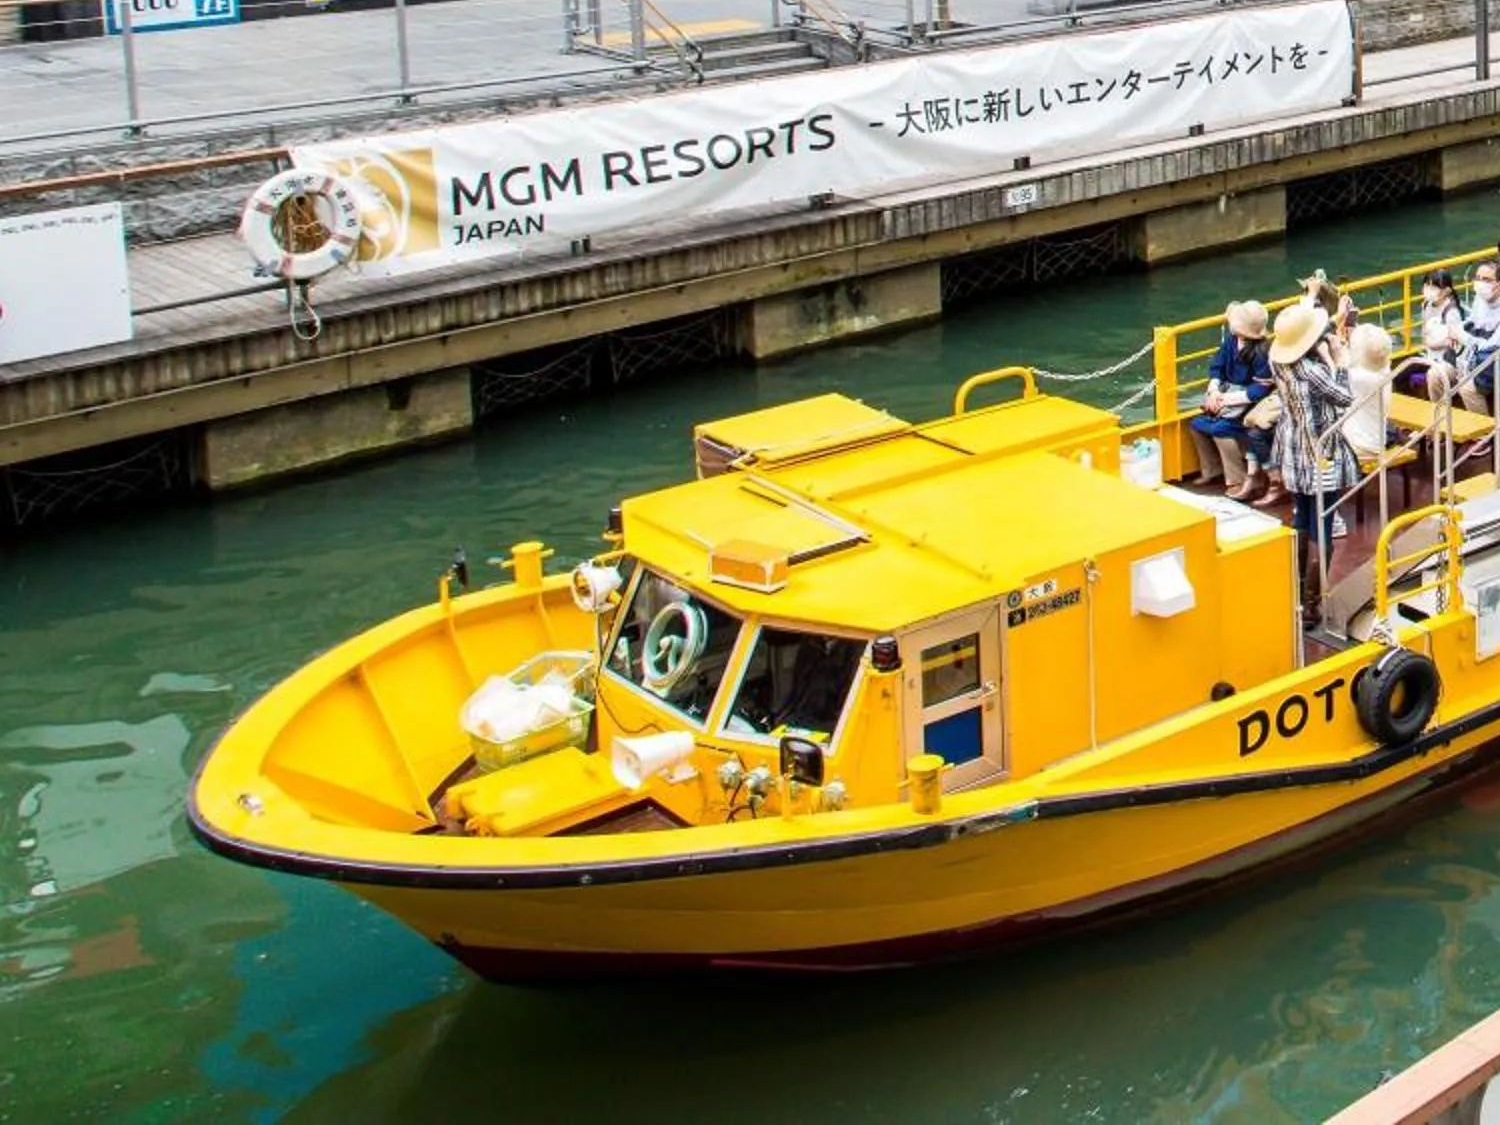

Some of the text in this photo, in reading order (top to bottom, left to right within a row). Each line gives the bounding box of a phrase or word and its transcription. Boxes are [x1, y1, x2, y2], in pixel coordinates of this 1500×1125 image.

[452, 113, 836, 217] MGM RESORTS
[452, 214, 545, 246] JAPAN
